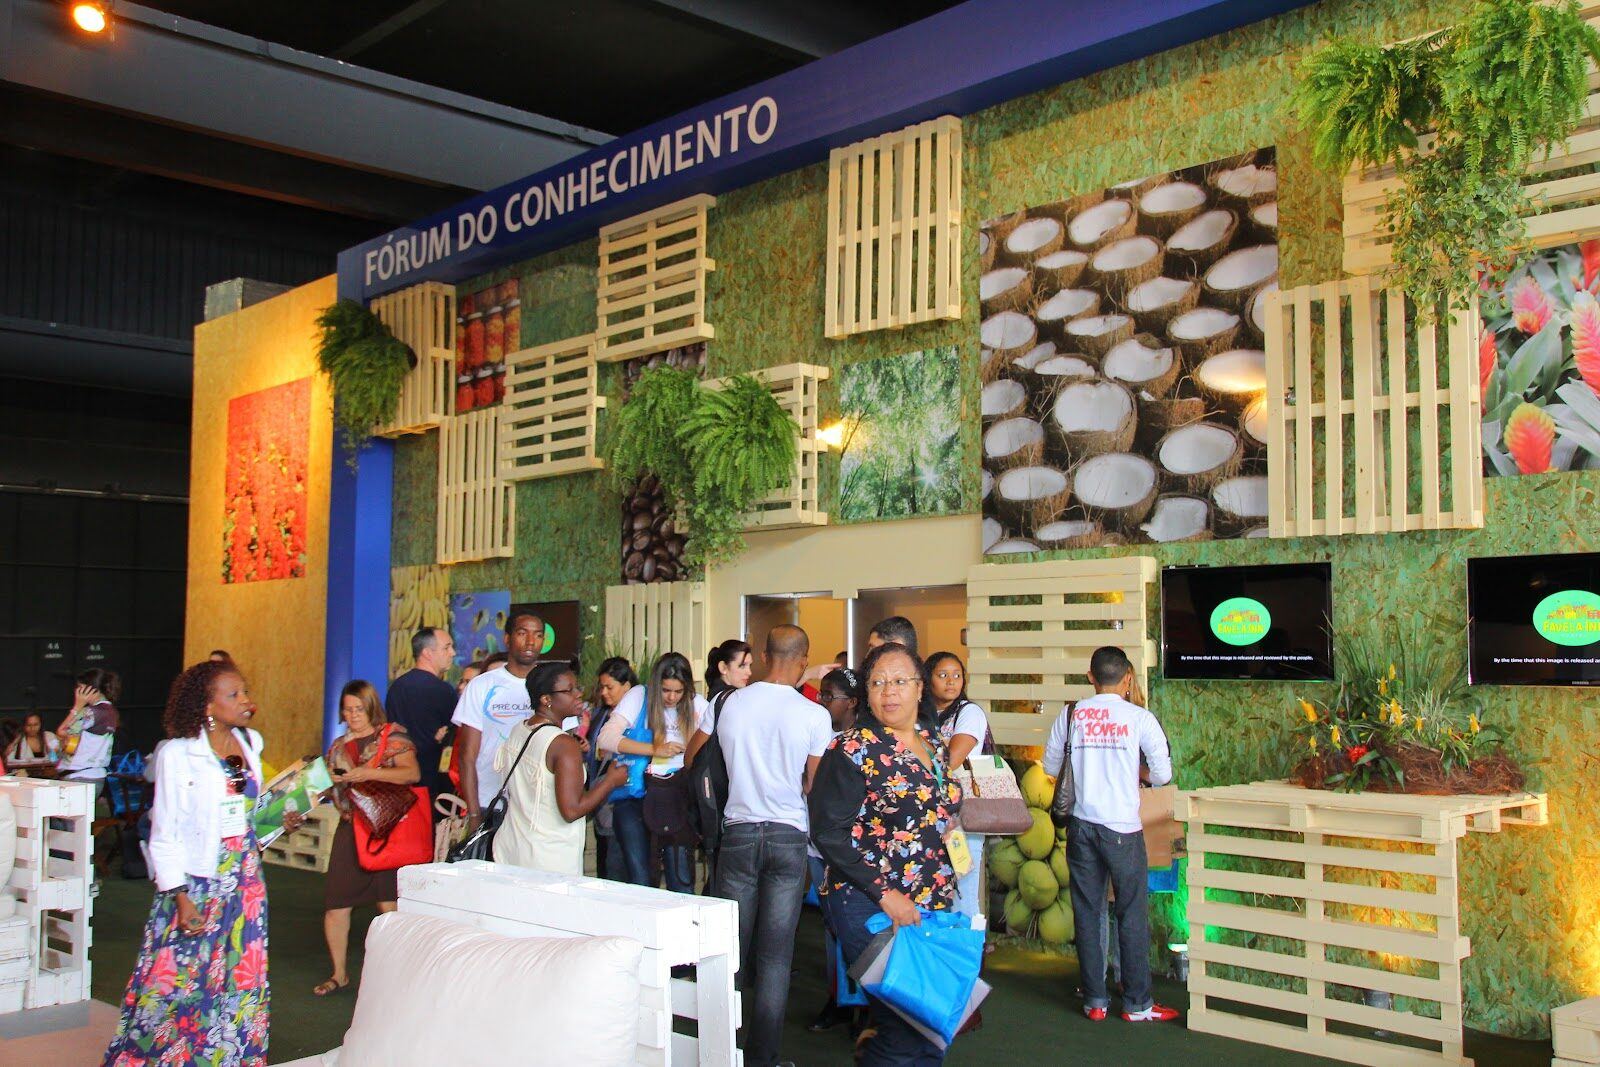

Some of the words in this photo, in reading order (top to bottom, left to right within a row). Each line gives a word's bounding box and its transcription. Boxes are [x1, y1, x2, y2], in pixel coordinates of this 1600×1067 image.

[365, 221, 451, 286] FÓRUM
[458, 205, 498, 251] DO
[504, 96, 778, 233] CONHECIMENTO
